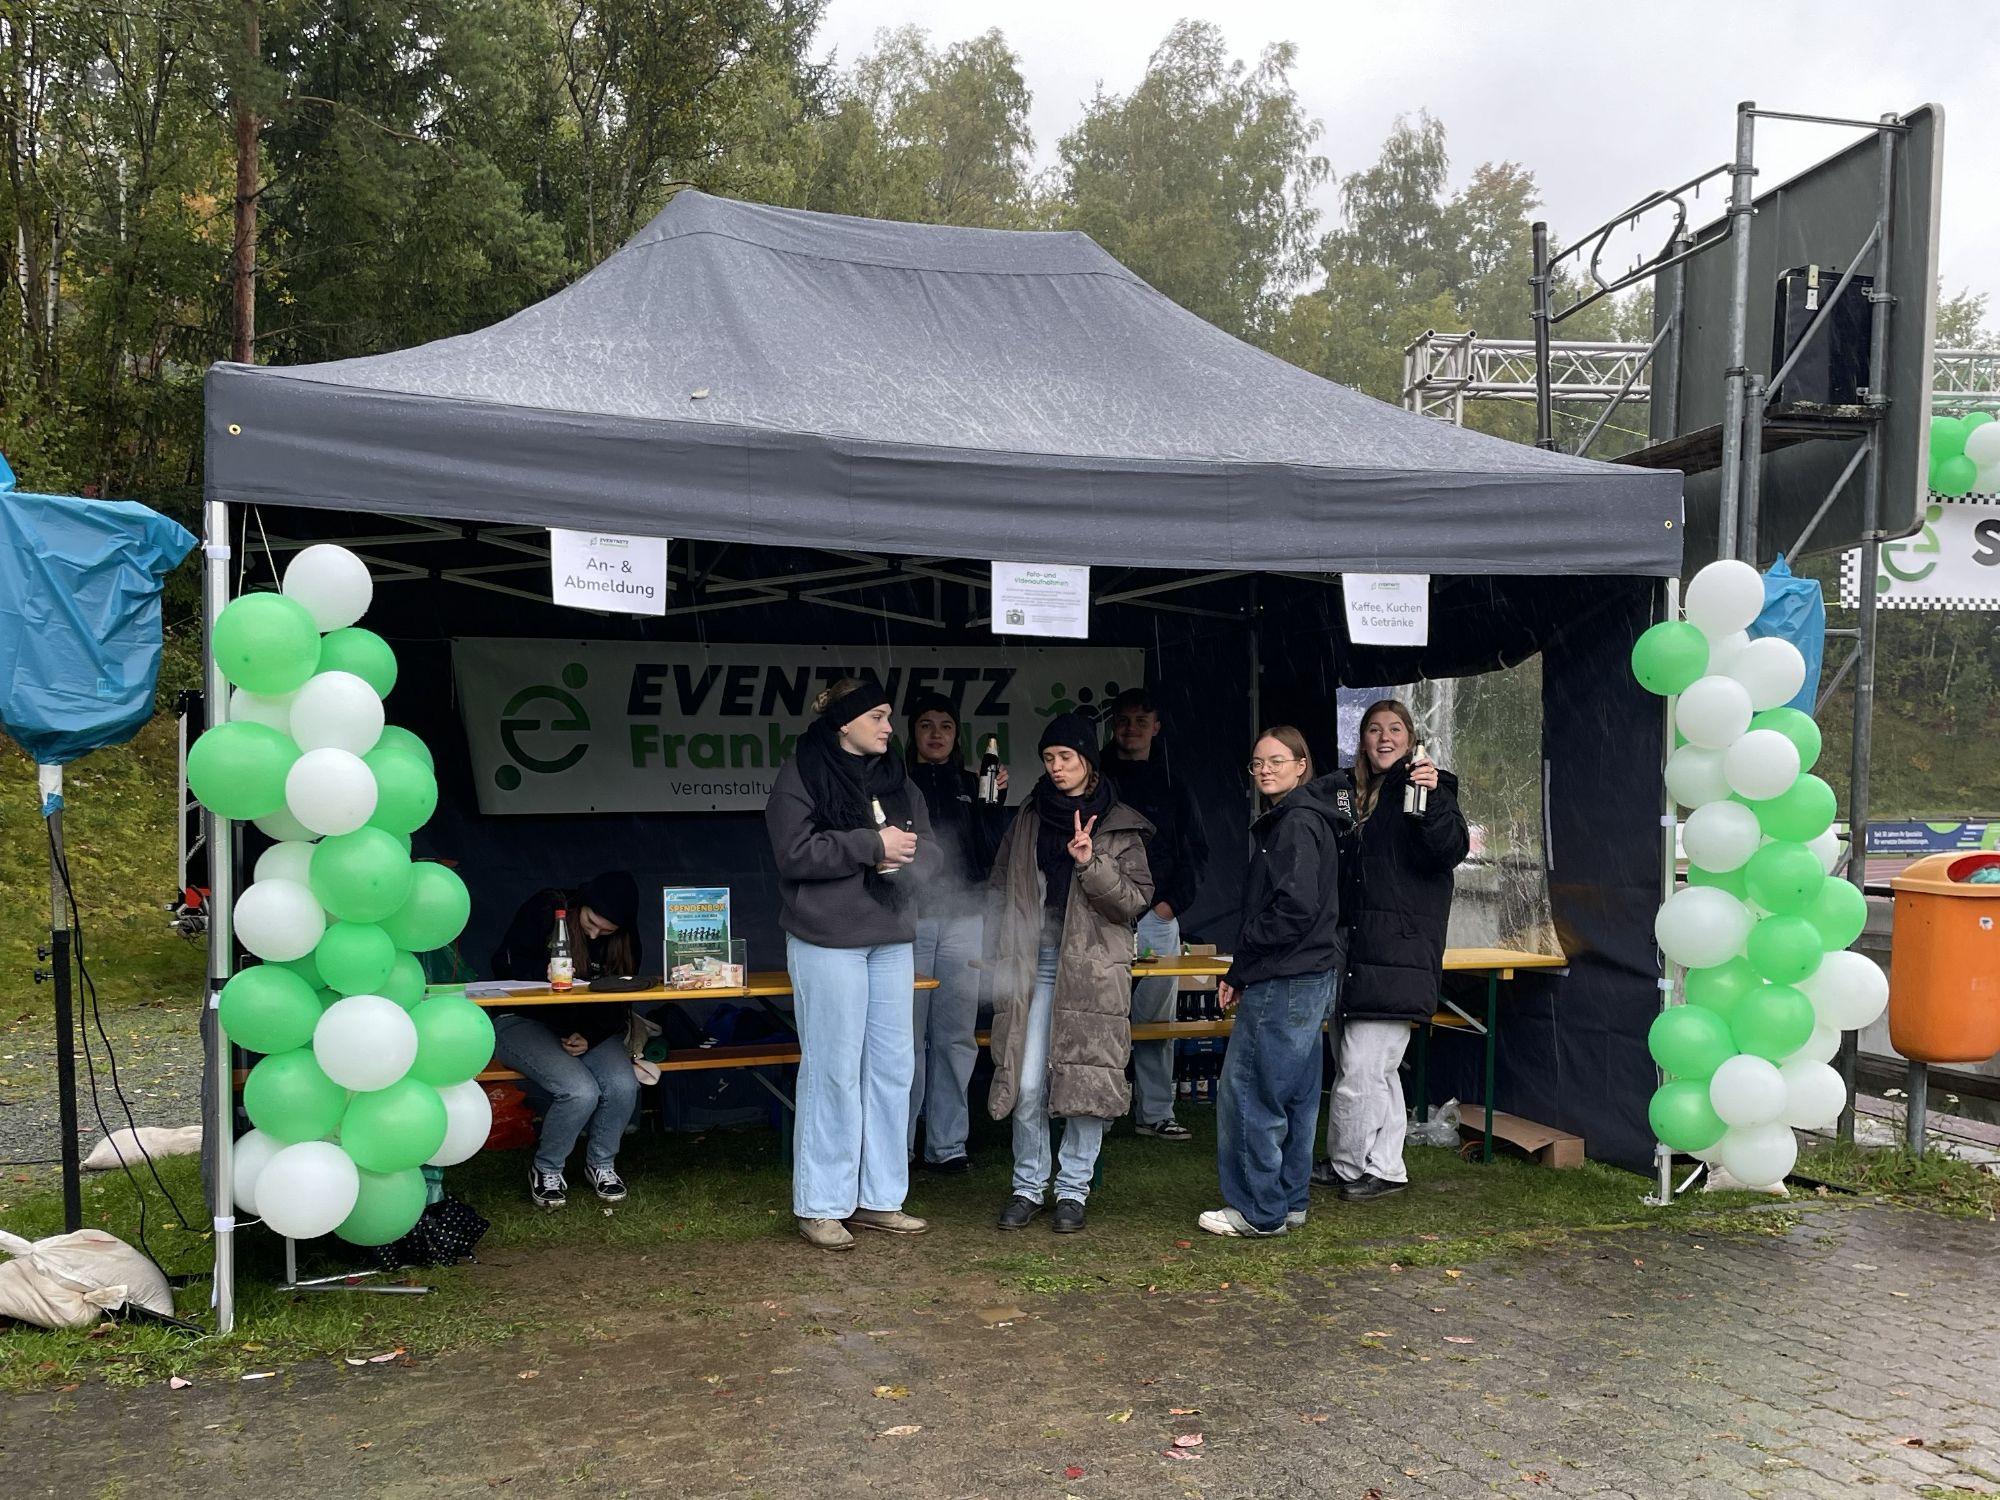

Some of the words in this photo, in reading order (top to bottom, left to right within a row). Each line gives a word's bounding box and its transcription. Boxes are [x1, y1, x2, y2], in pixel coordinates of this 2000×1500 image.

[586, 557, 615, 572] An-
[621, 560, 632, 573] &
[564, 575, 654, 598] Abmeldung
[1351, 601, 1384, 613] Kaffee,
[1386, 602, 1422, 613] Kuchen
[1361, 616, 1369, 626] &
[1371, 616, 1414, 628] Getränke
[630, 722, 1010, 769] Frankld
[671, 781, 773, 796] Veranstaltu
